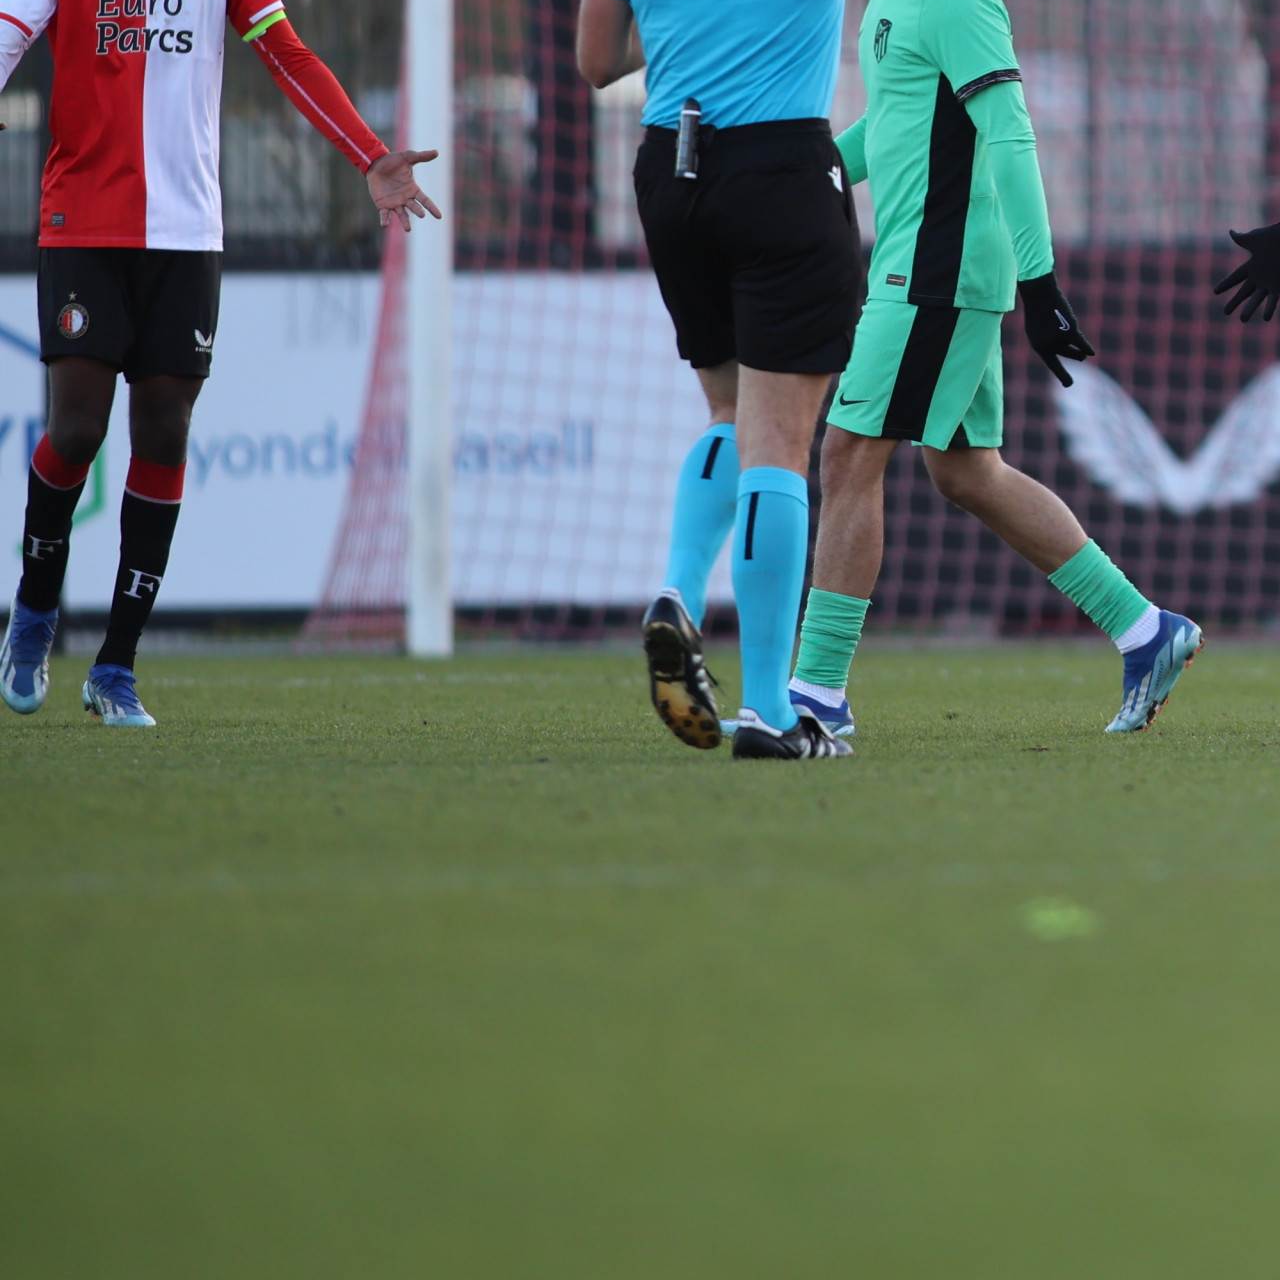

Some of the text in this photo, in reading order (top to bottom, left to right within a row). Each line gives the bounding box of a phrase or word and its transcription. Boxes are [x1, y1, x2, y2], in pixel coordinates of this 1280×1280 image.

[96, 22, 194, 55] Parcs
[26, 534, 63, 560] F
[123, 568, 163, 599] F
